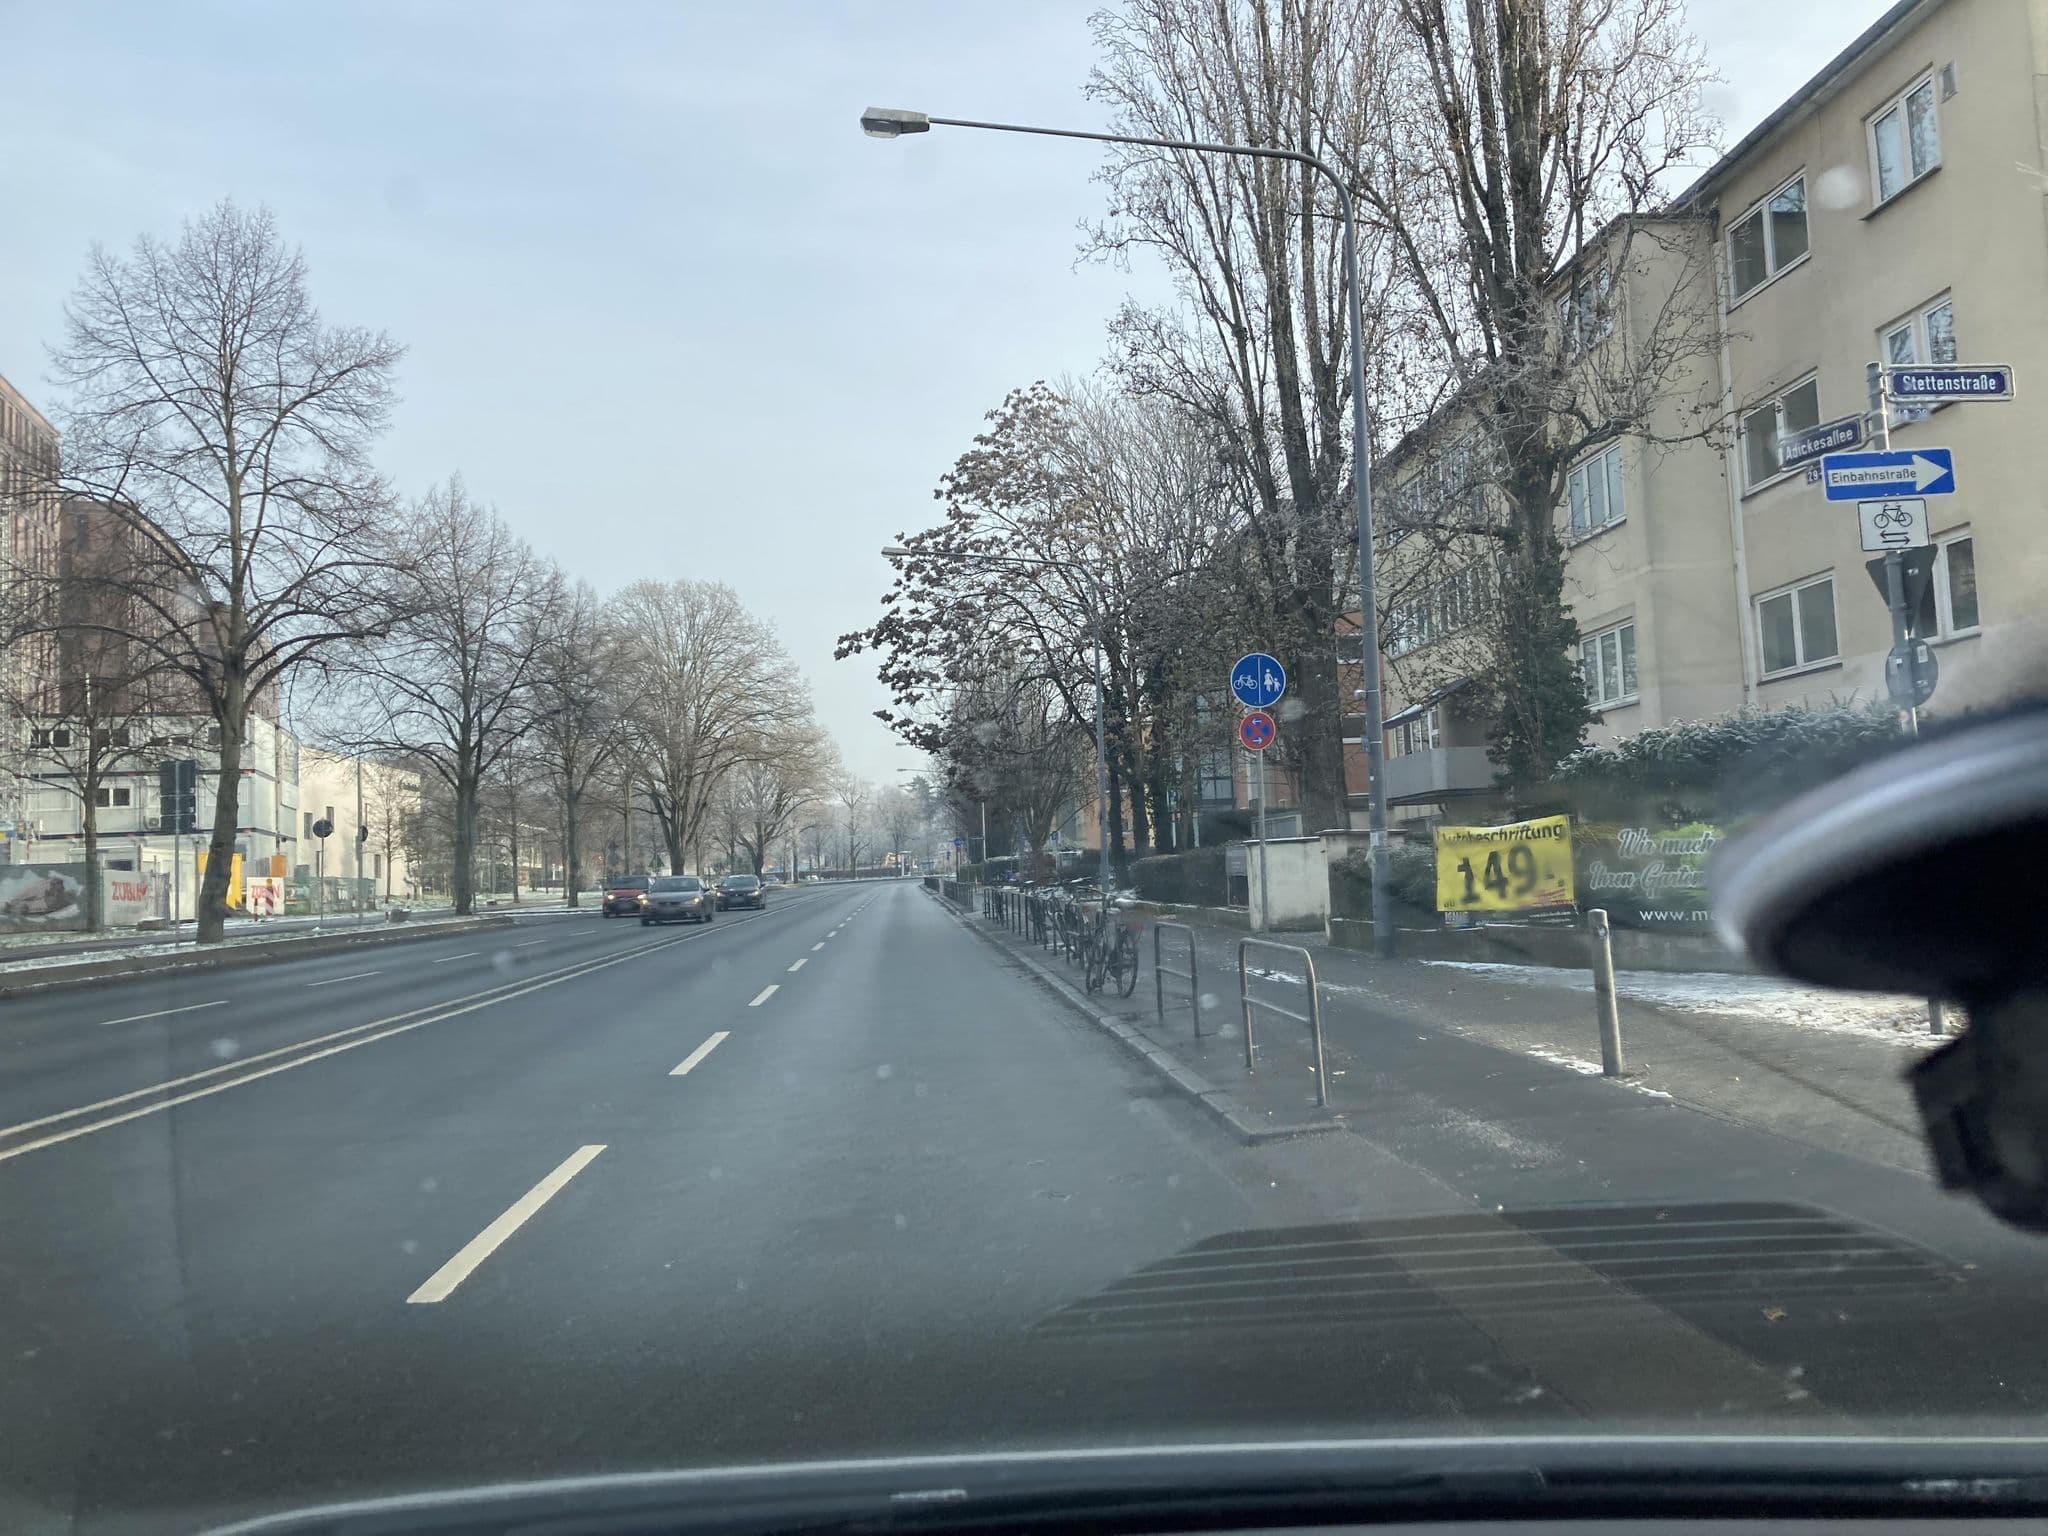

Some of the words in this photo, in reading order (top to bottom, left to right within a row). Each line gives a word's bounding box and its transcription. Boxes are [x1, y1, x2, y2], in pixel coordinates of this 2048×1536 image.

[1902, 374, 1997, 393] Stettenstraße
[1785, 429, 1854, 461] Adickesallee
[1831, 468, 1917, 484] Einbahnstraße
